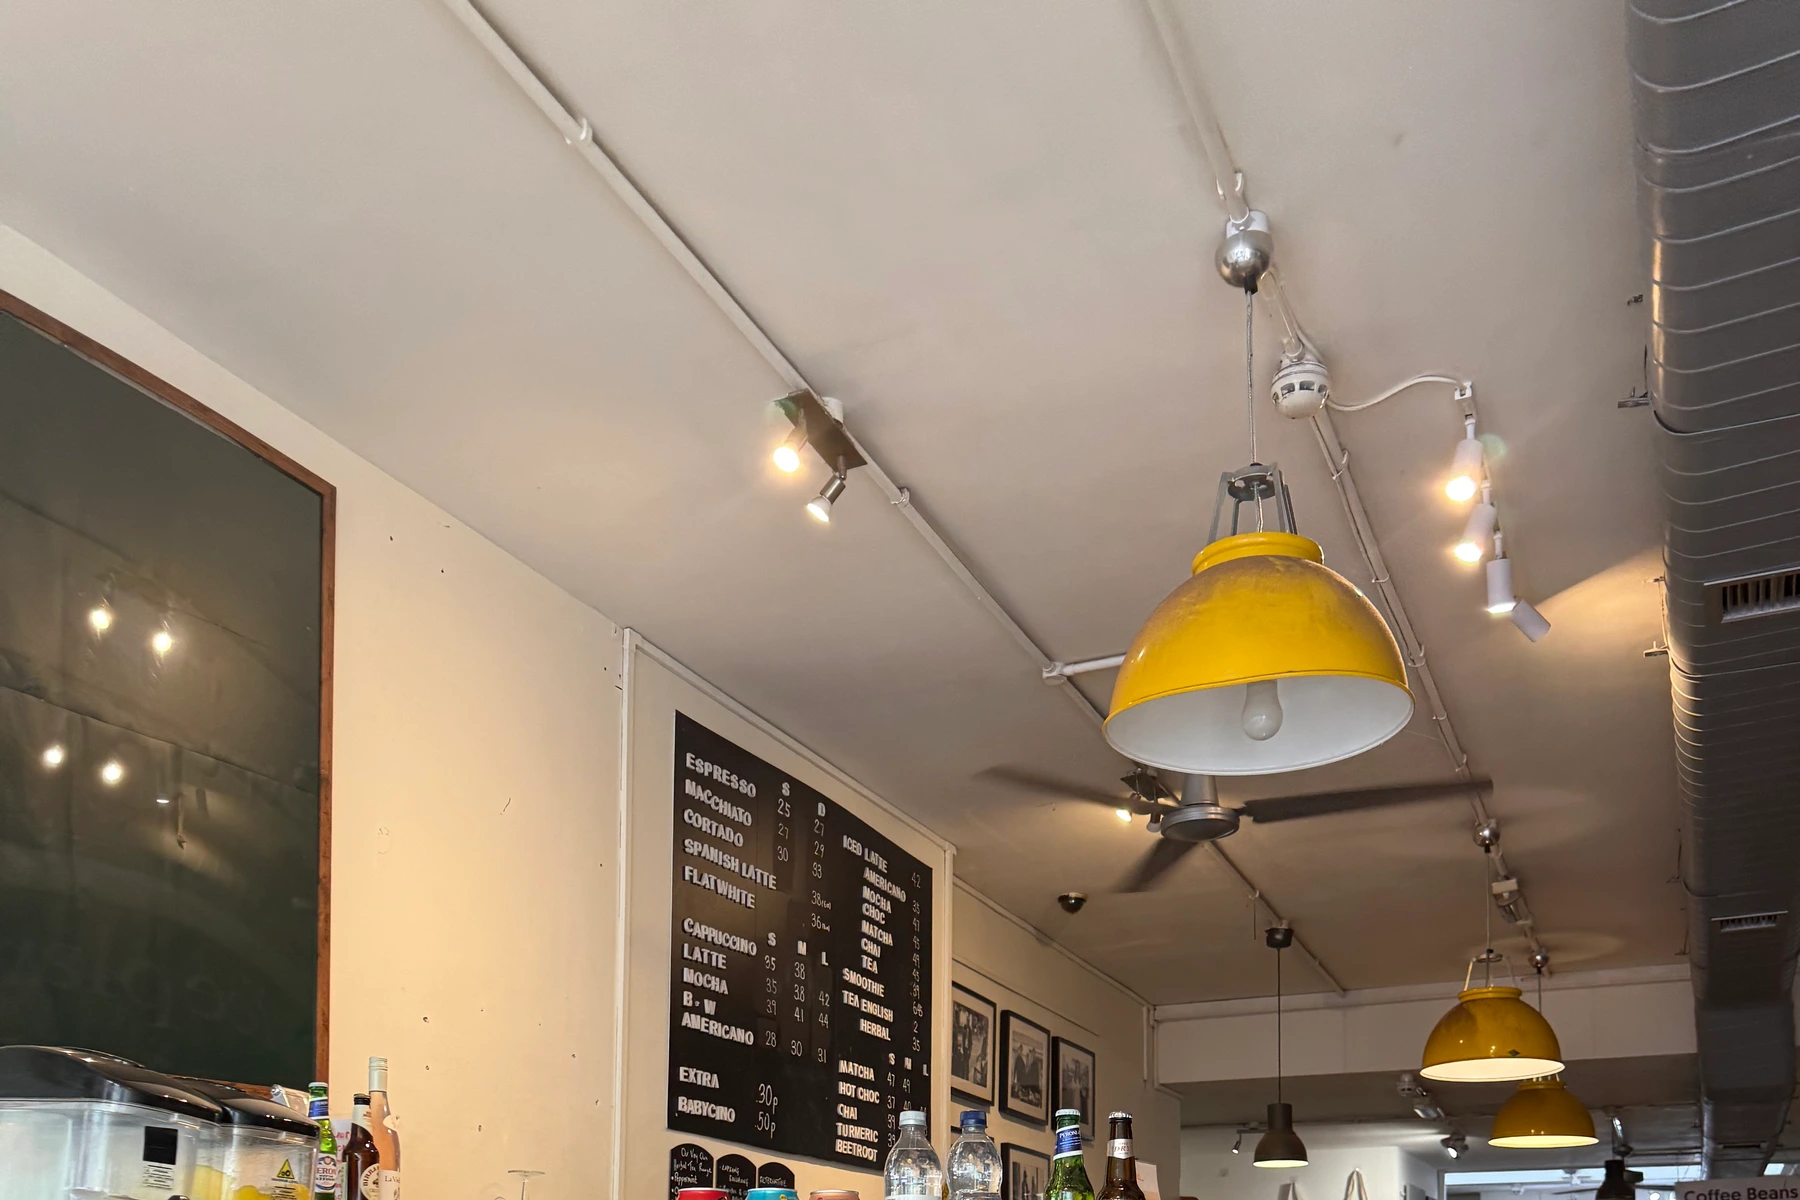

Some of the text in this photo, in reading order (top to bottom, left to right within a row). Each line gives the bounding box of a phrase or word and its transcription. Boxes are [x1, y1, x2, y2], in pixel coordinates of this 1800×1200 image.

[686, 752, 757, 798] ESPRESSO
[685, 779, 752, 826] MACCHIATO
[777, 798, 791, 817] 25
[781, 782, 826, 817] S D
[684, 808, 744, 847] CORTADO
[684, 838, 777, 890] SPANISH LATTE
[777, 845, 789, 862] 30
[843, 834, 863, 856] ICED
[864, 847, 888, 874] LATTE
[684, 865, 755, 909] FLATWHITE
[863, 867, 907, 903] AMERICANO
[862, 885, 892, 914] MOCHA
[862, 902, 886, 925] CHOC
[683, 917, 757, 956] CAPPUCCINO
[861, 920, 893, 946] MATCHA
[683, 943, 727, 970] LATTE
[767, 932, 829, 966] S M L
[861, 938, 881, 958] CHAI
[861, 955, 879, 974] TEA
[683, 967, 729, 995] MOCHA
[842, 967, 885, 998] SMOOTHIE
[683, 990, 693, 1007] B
[703, 998, 717, 1015] W
[842, 989, 860, 1008] TEA
[861, 998, 894, 1023] ENGLISH
[681, 1012, 755, 1045] AMERICANO
[860, 1018, 892, 1041] HERBAL
[679, 1066, 719, 1089] EXTRA
[839, 1059, 875, 1082] MATCHA
[888, 1053, 929, 1077] S M L
[838, 1081, 856, 1098] HOT
[857, 1087, 880, 1104] CHOC
[678, 1096, 736, 1123] BABYCINO
[836, 1103, 858, 1120] CHAI
[836, 1122, 879, 1143] TURMERIC
[835, 1139, 878, 1162] BEETROOT
[1747, 1187, 1799, 1200] Beans
